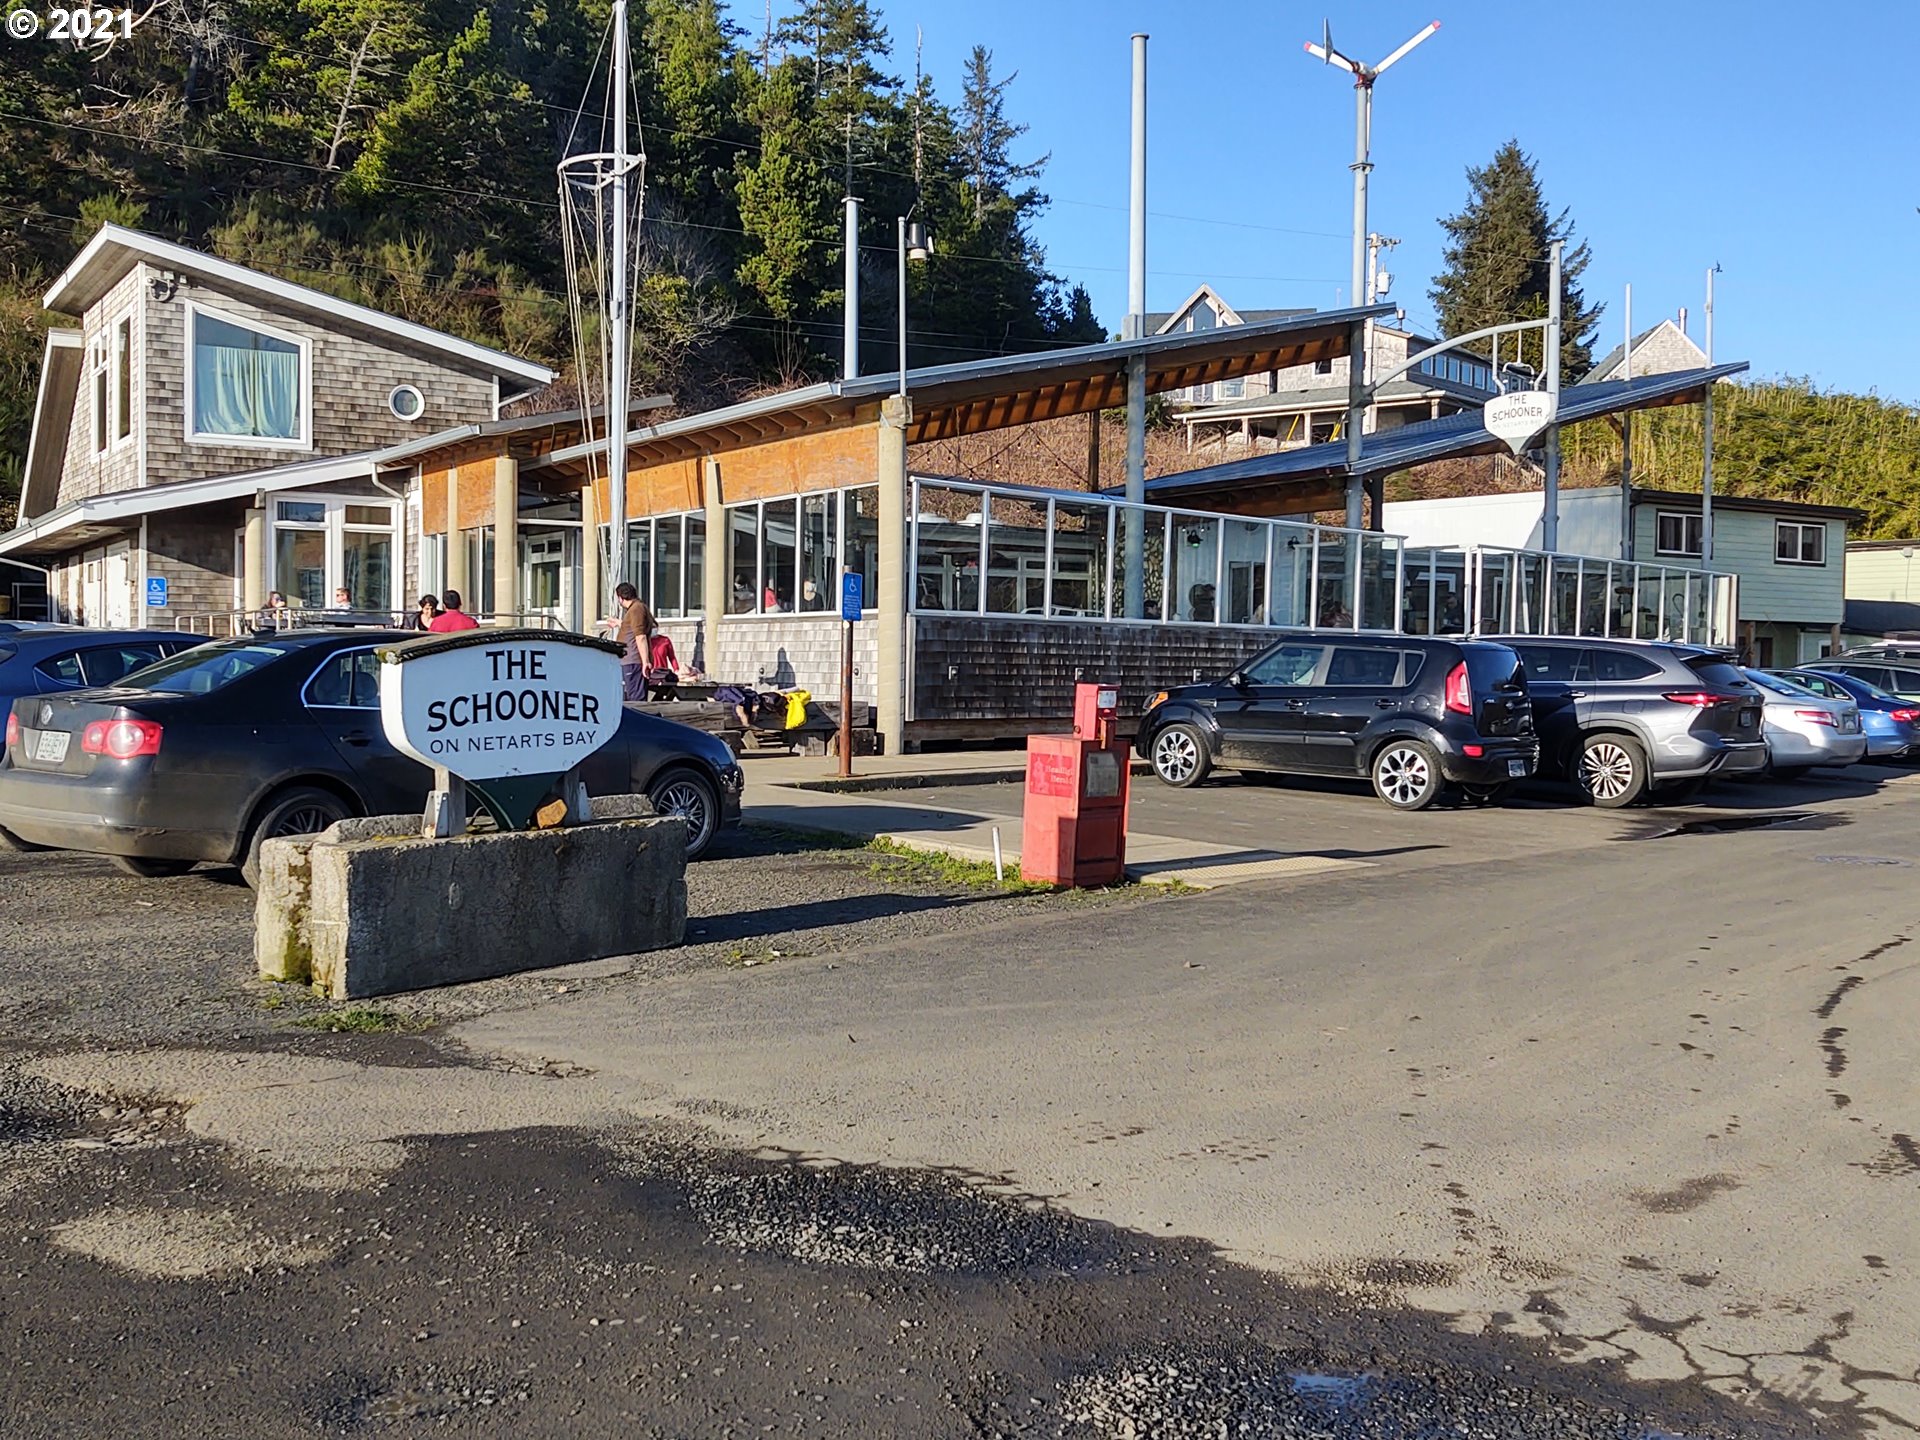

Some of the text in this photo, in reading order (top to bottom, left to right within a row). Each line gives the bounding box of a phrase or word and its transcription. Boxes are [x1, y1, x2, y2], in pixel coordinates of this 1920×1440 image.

[1508, 394, 1527, 405] THE
[1492, 407, 1543, 423] SCHOONER
[486, 650, 547, 681] THE
[427, 689, 601, 733] SCHOONER
[430, 730, 597, 755] ON NETARTS BAY
